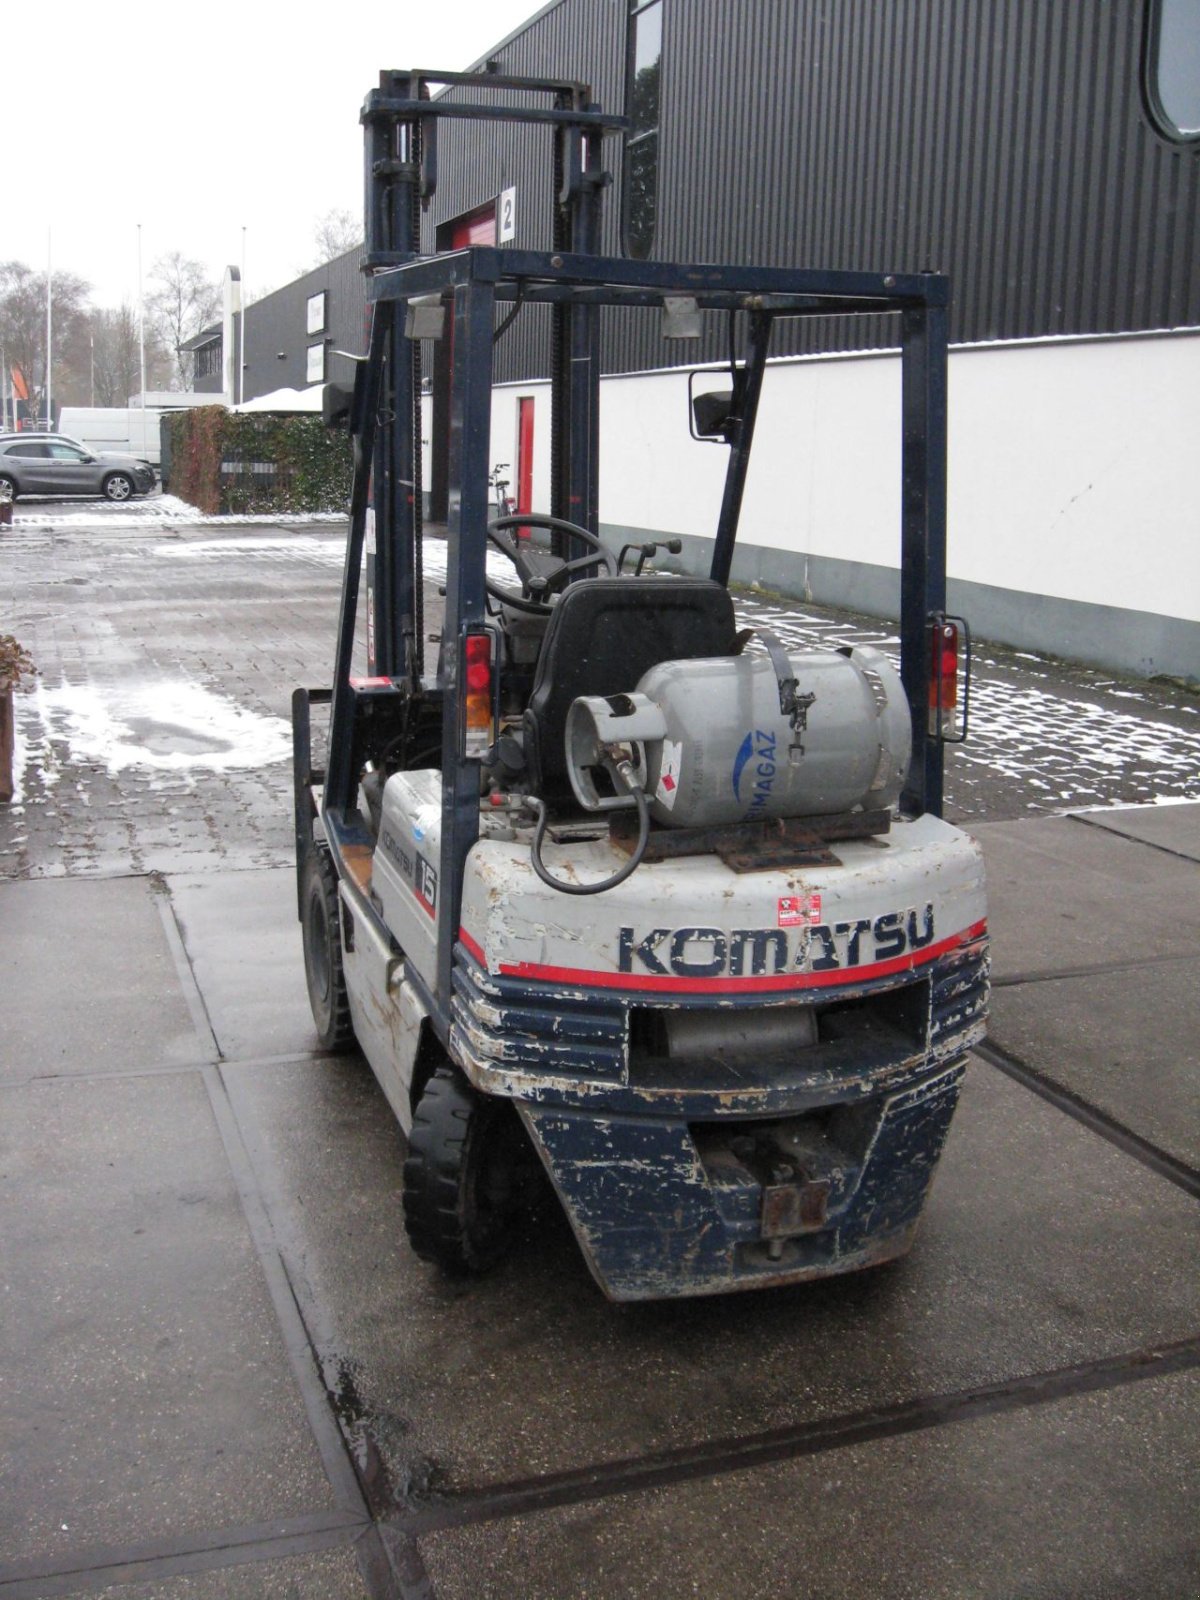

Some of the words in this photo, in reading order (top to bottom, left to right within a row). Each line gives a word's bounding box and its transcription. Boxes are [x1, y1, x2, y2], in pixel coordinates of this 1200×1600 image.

[504, 198, 512, 230] 2
[742, 729, 777, 822] RIMAGAZ
[421, 859, 435, 906] 15
[618, 903, 935, 977] KOMATSU
